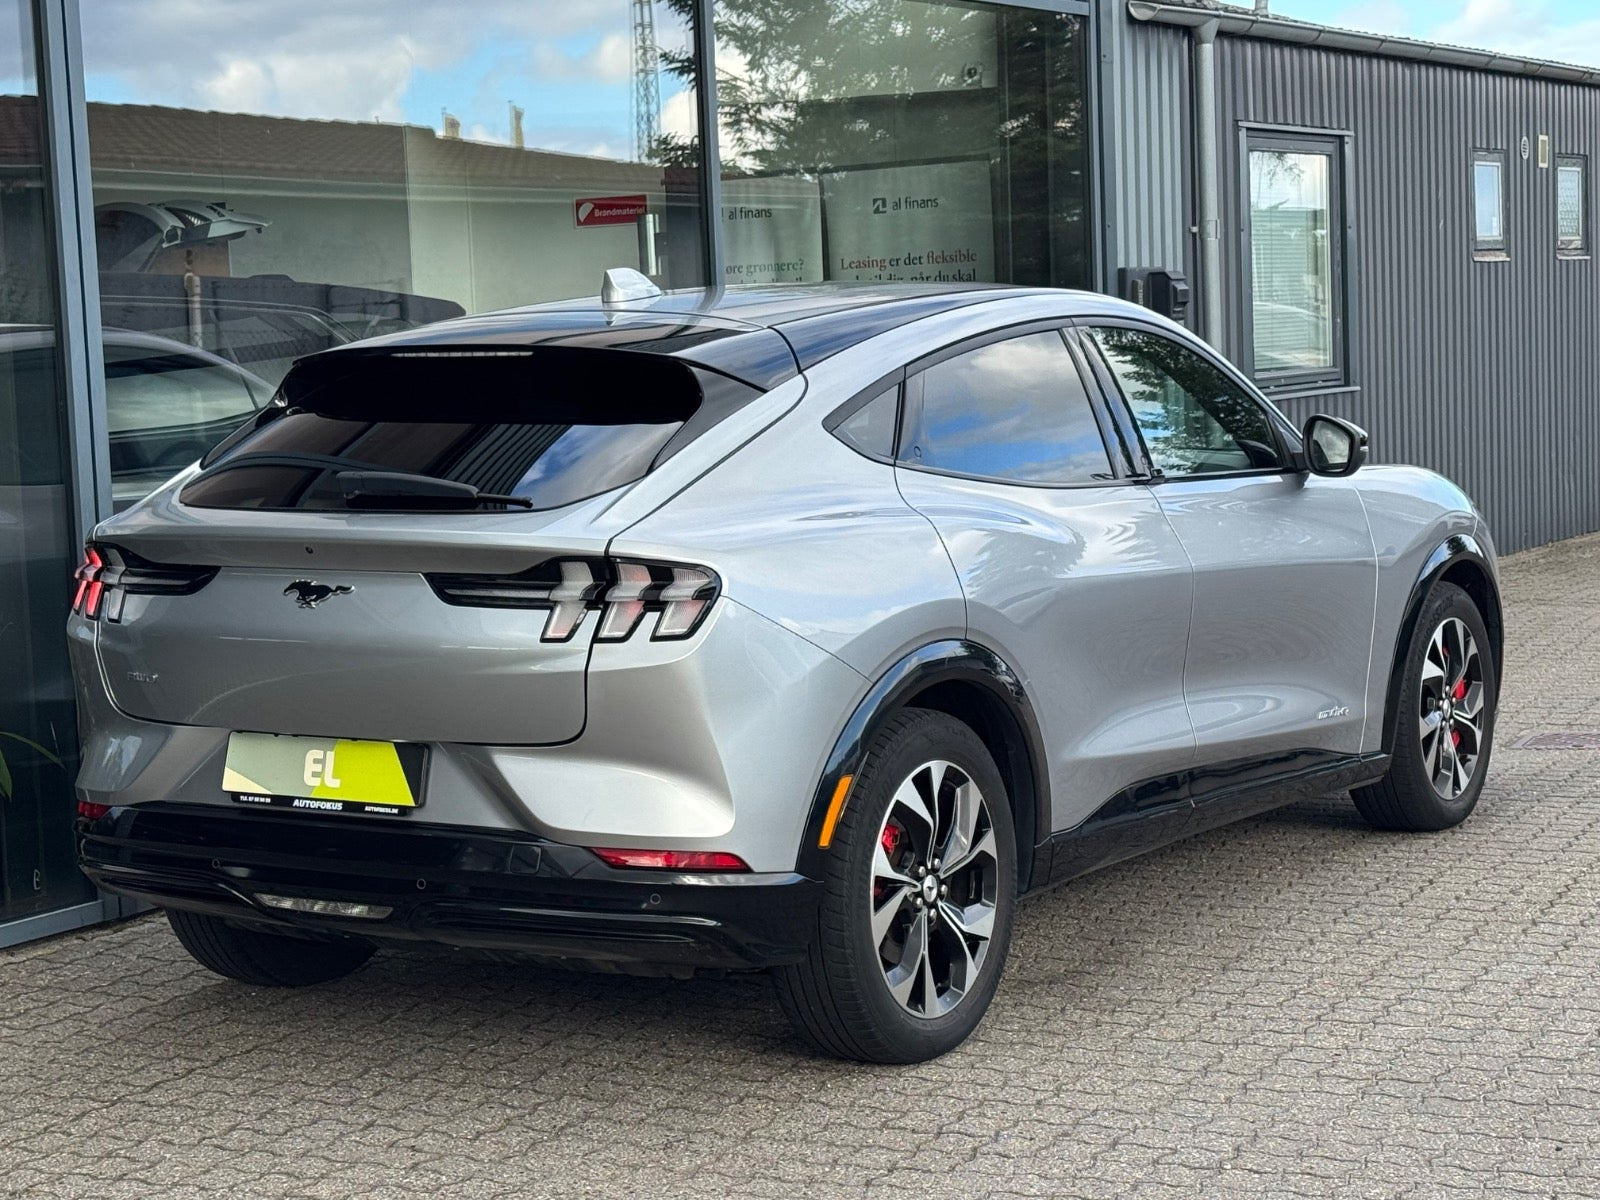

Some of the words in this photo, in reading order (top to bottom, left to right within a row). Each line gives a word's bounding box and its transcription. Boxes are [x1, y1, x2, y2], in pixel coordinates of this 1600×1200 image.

[892, 197, 901, 211] al
[904, 196, 939, 210] finans
[728, 207, 737, 221] al
[739, 206, 773, 220] finans
[840, 255, 887, 271] Leasing
[889, 257, 901, 267] er
[903, 252, 924, 267] det
[926, 249, 978, 265] fleksible
[952, 268, 977, 283] skal
[303, 749, 341, 788] EL
[292, 799, 343, 811] AUTOFOKUS
